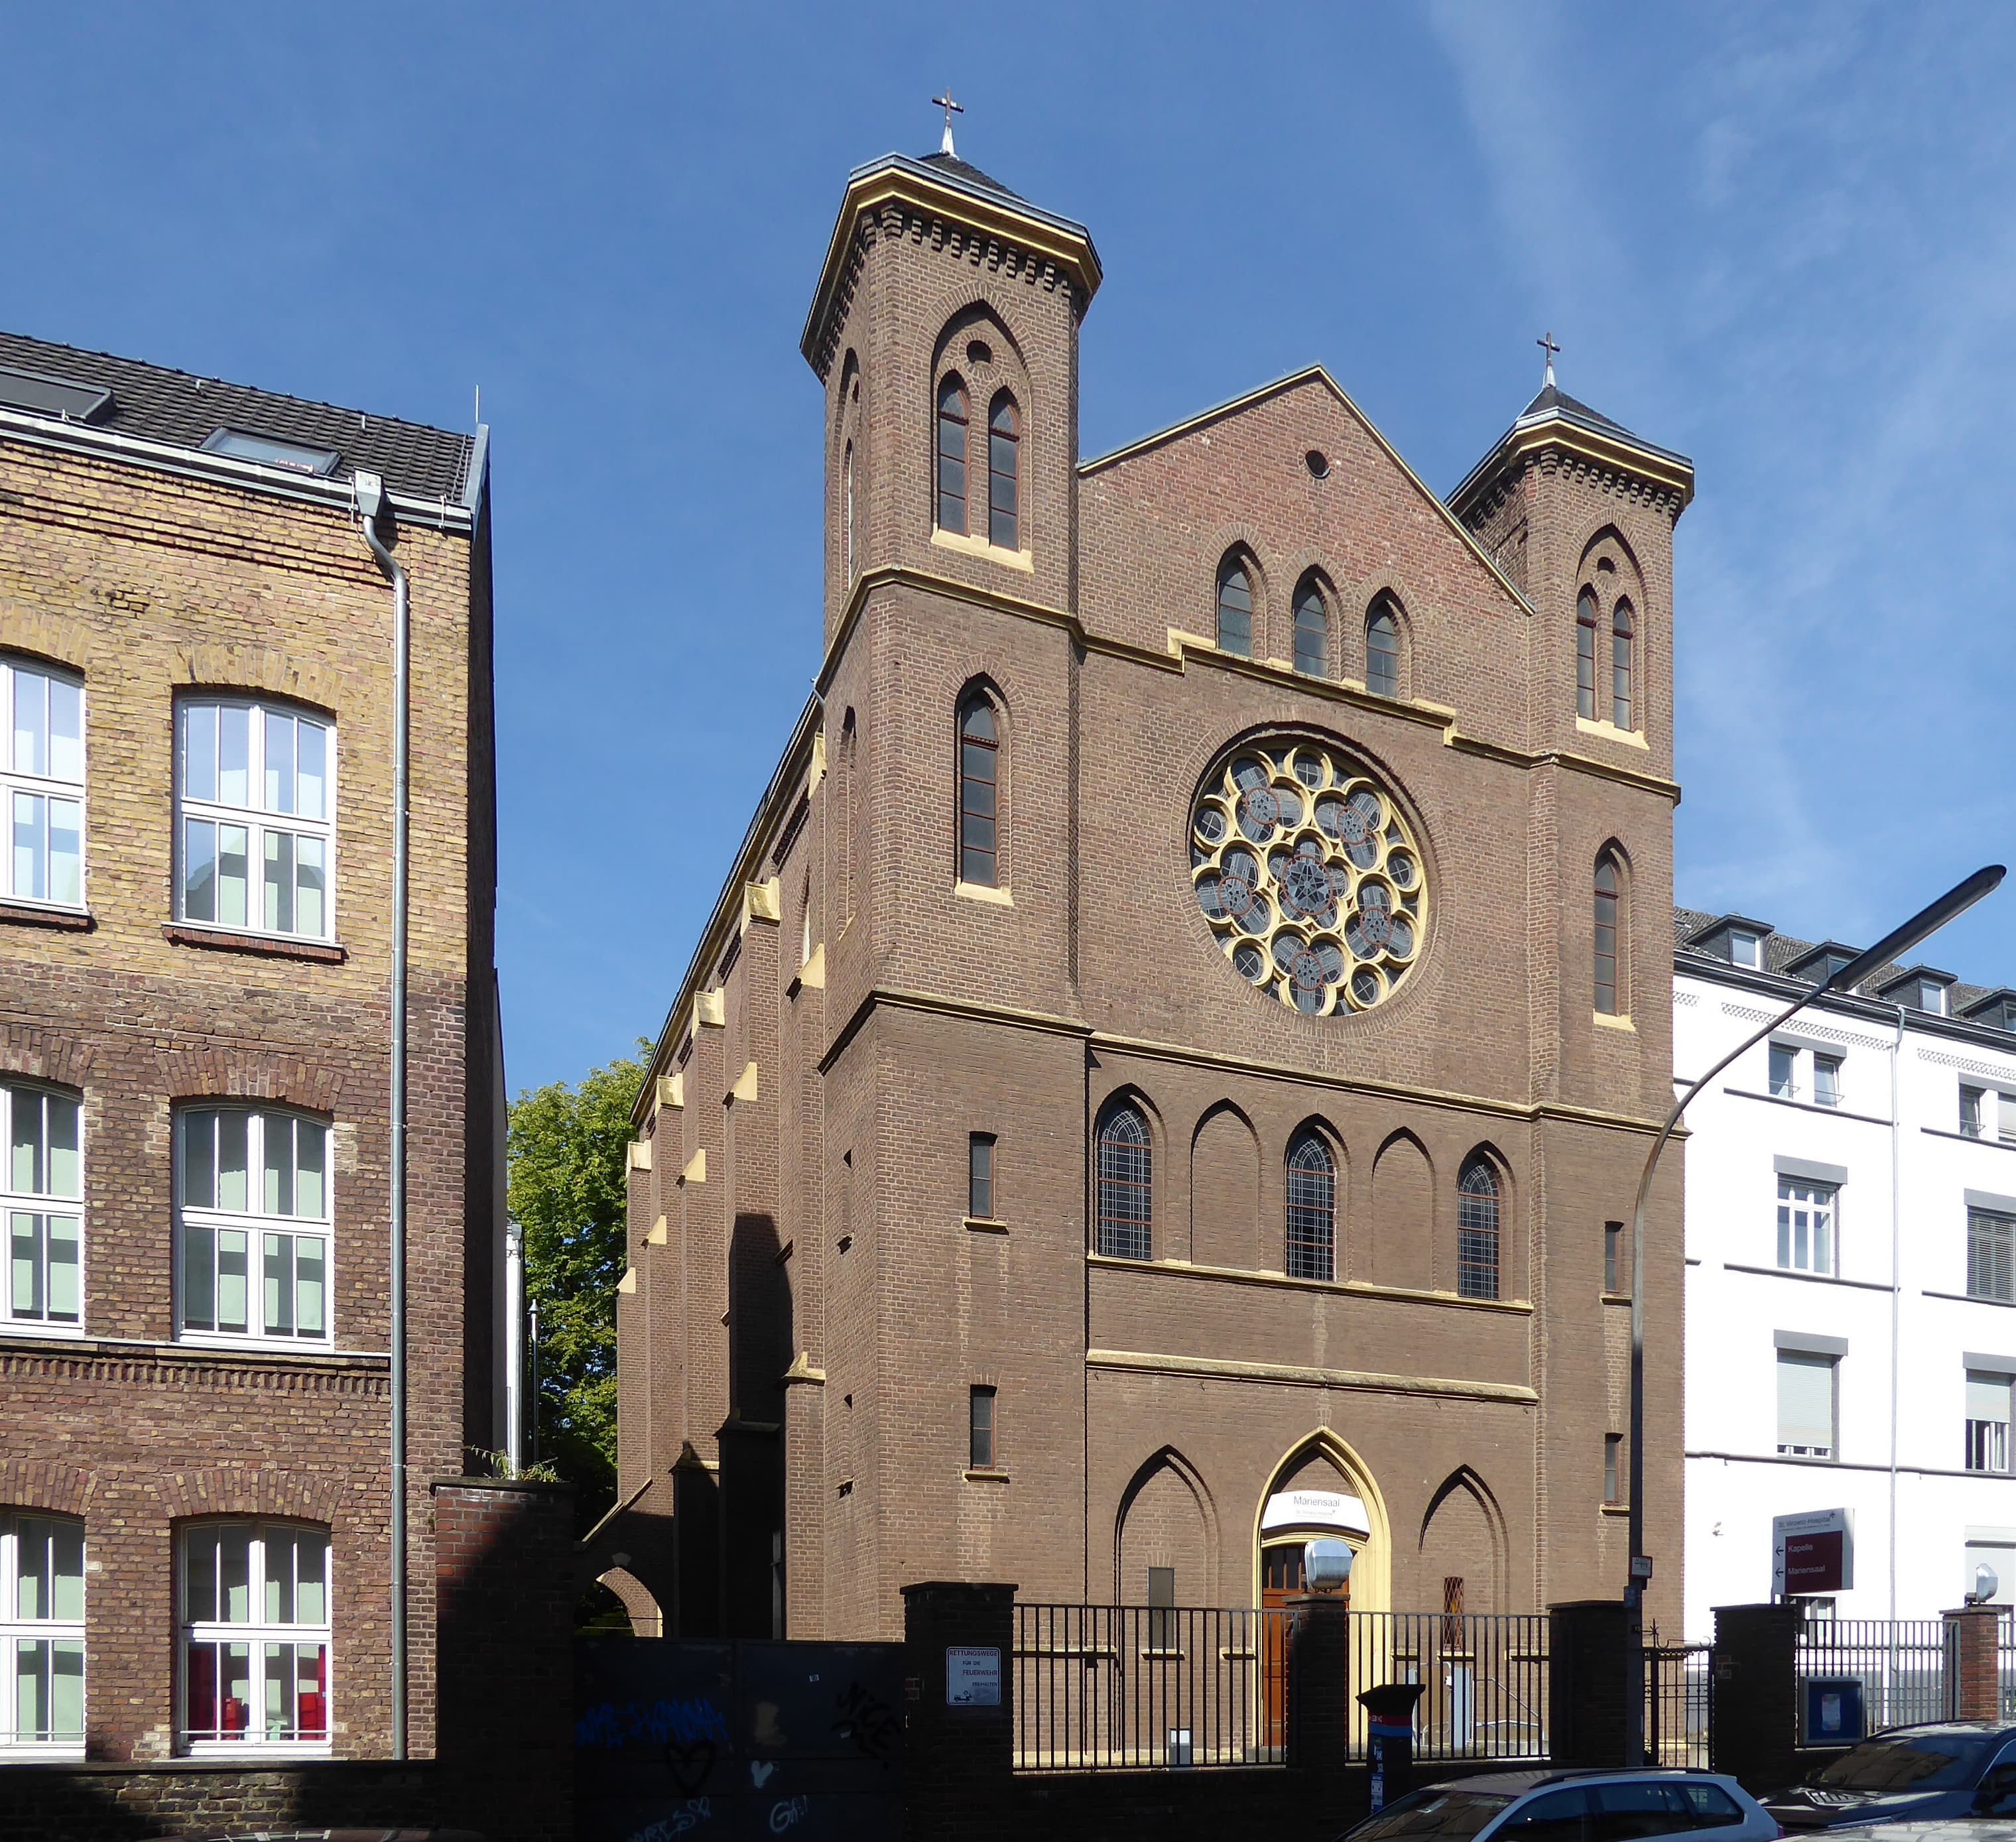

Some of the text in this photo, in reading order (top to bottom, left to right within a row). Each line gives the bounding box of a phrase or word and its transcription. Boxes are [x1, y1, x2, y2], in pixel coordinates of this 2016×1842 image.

[1294, 1495, 1340, 1507] Mariensaal
[1788, 1544, 1813, 1553] Kapelle
[1788, 1565, 1825, 1575] Mariensaal
